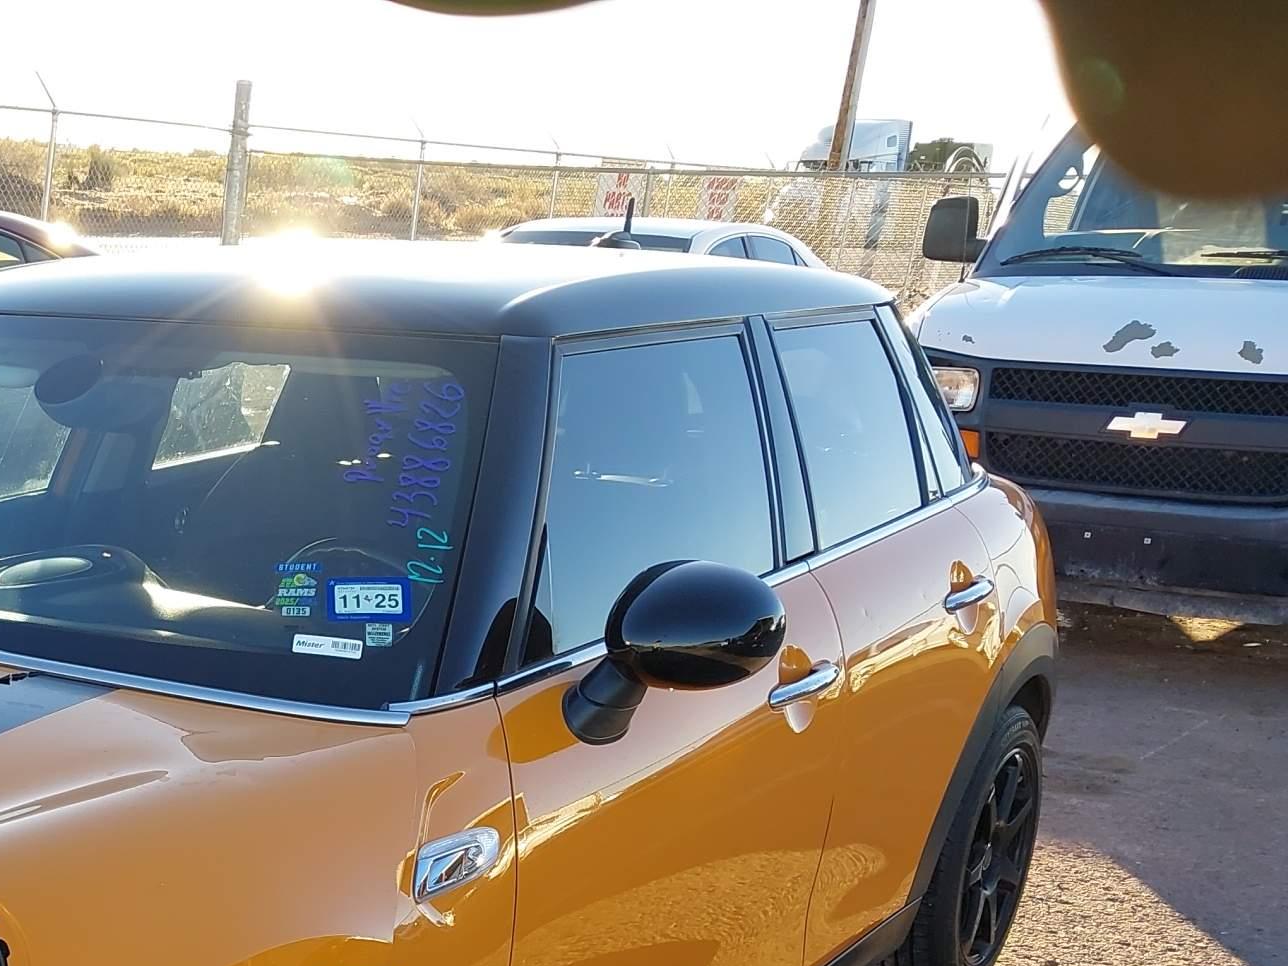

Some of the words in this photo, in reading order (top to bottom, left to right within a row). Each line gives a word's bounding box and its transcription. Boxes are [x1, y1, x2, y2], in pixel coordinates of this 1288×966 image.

[387, 382, 465, 527] 43886826
[406, 527, 454, 584] 12.12
[278, 562, 317, 571] STUDENT
[277, 588, 317, 597] RAMS
[295, 639, 325, 649] Mister
